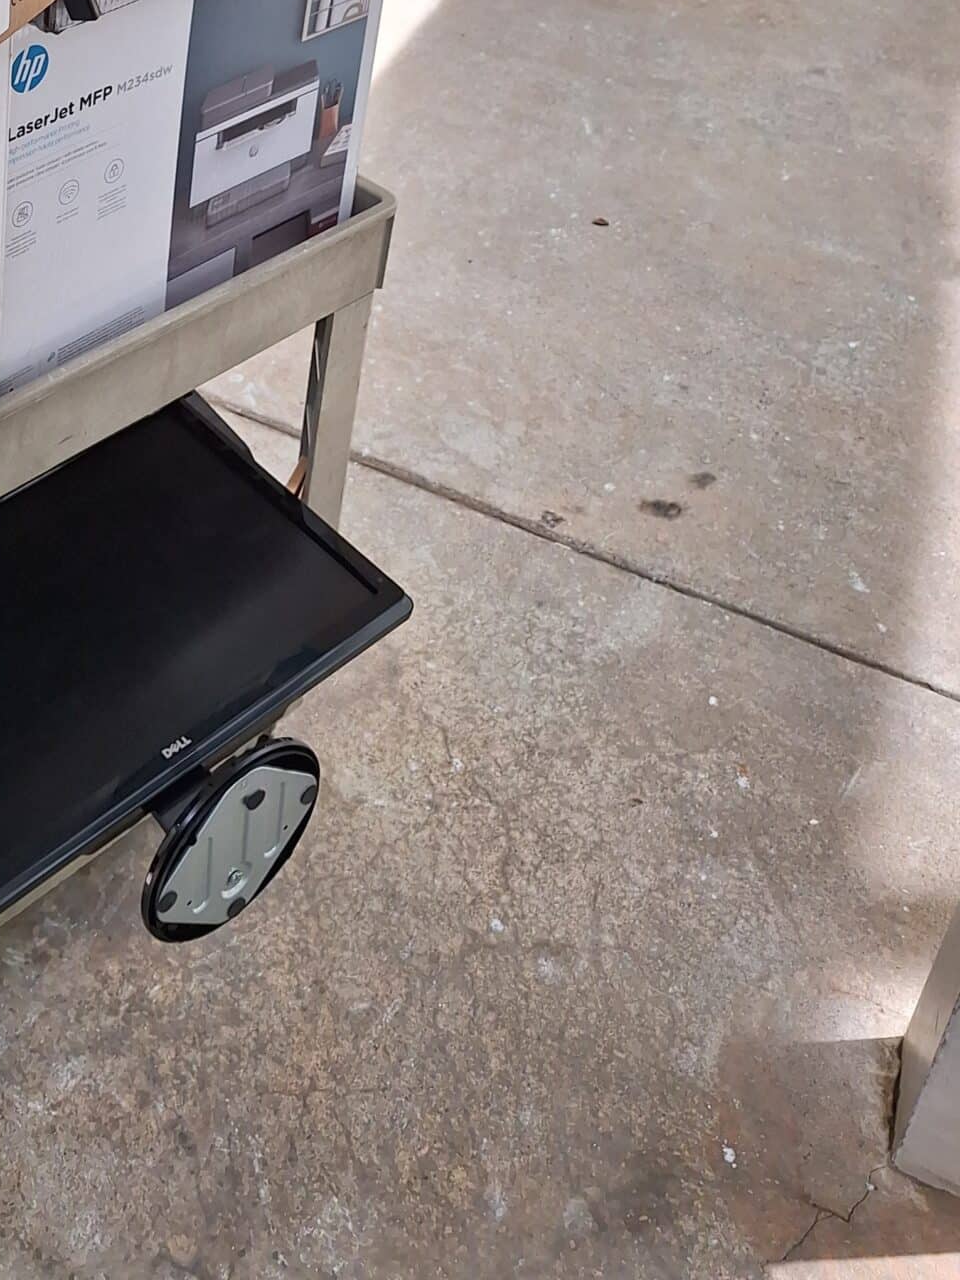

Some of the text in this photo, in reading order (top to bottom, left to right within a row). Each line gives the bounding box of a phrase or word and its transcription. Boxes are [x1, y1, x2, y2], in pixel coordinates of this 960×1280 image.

[11, 45, 49, 93] hp
[8, 64, 173, 142] LaserJet MFP M234sdw
[161, 736, 192, 759] DELL
